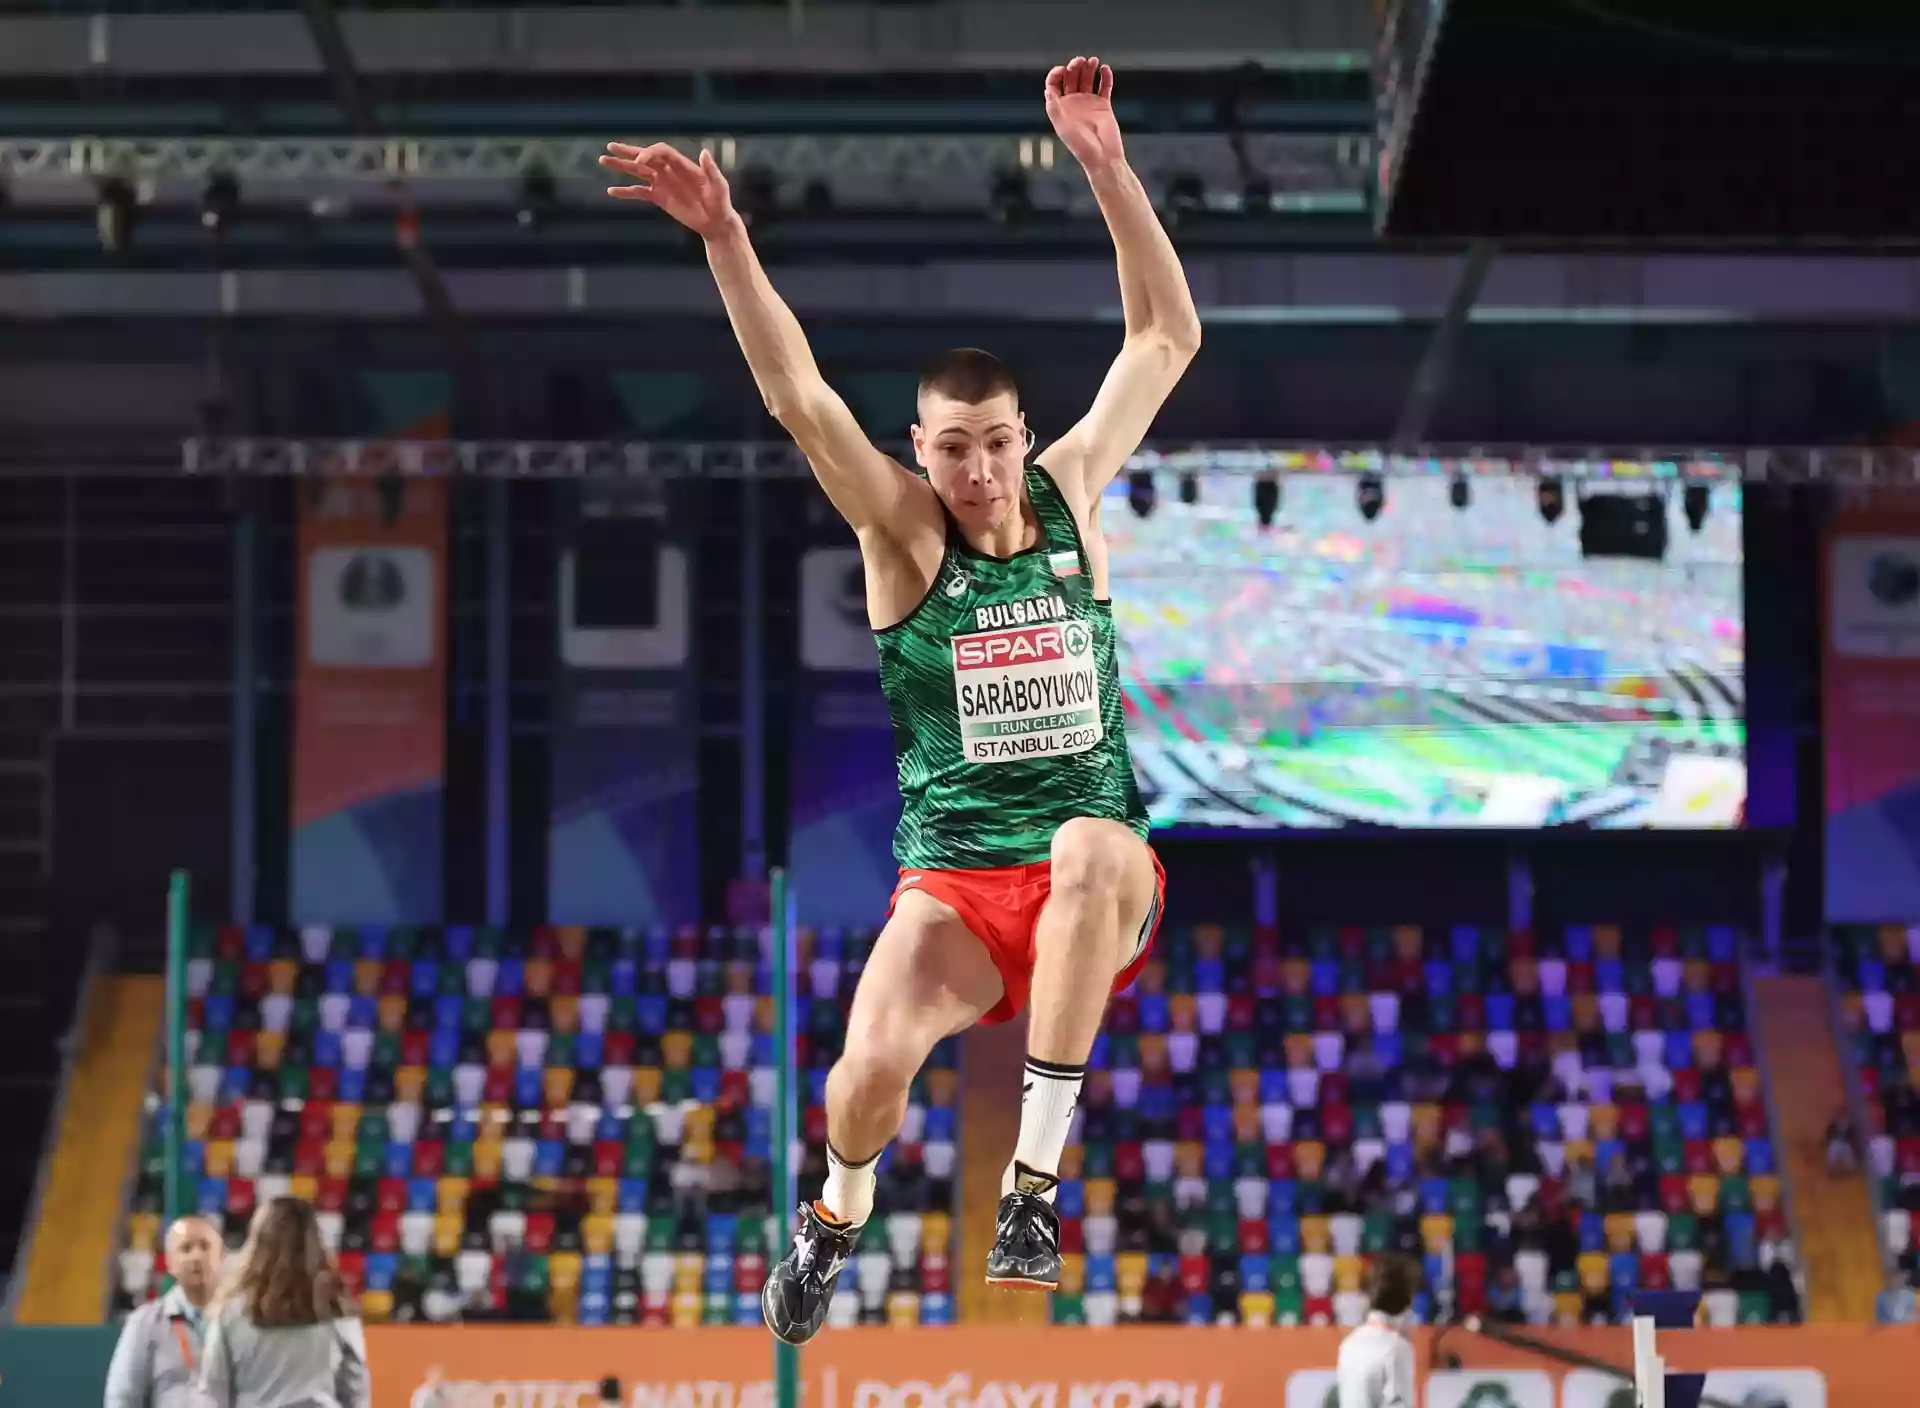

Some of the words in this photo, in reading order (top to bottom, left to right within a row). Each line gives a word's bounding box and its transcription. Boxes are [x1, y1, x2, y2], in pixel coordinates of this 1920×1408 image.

[975, 596, 1067, 630] BULGARIA
[959, 632, 1062, 666] SPAR
[962, 669, 1093, 717] SARÂBOYUKOV
[973, 735, 1060, 758] ISTANBUL
[1062, 729, 1097, 748] 2023
[1000, 721, 1031, 733] RUN
